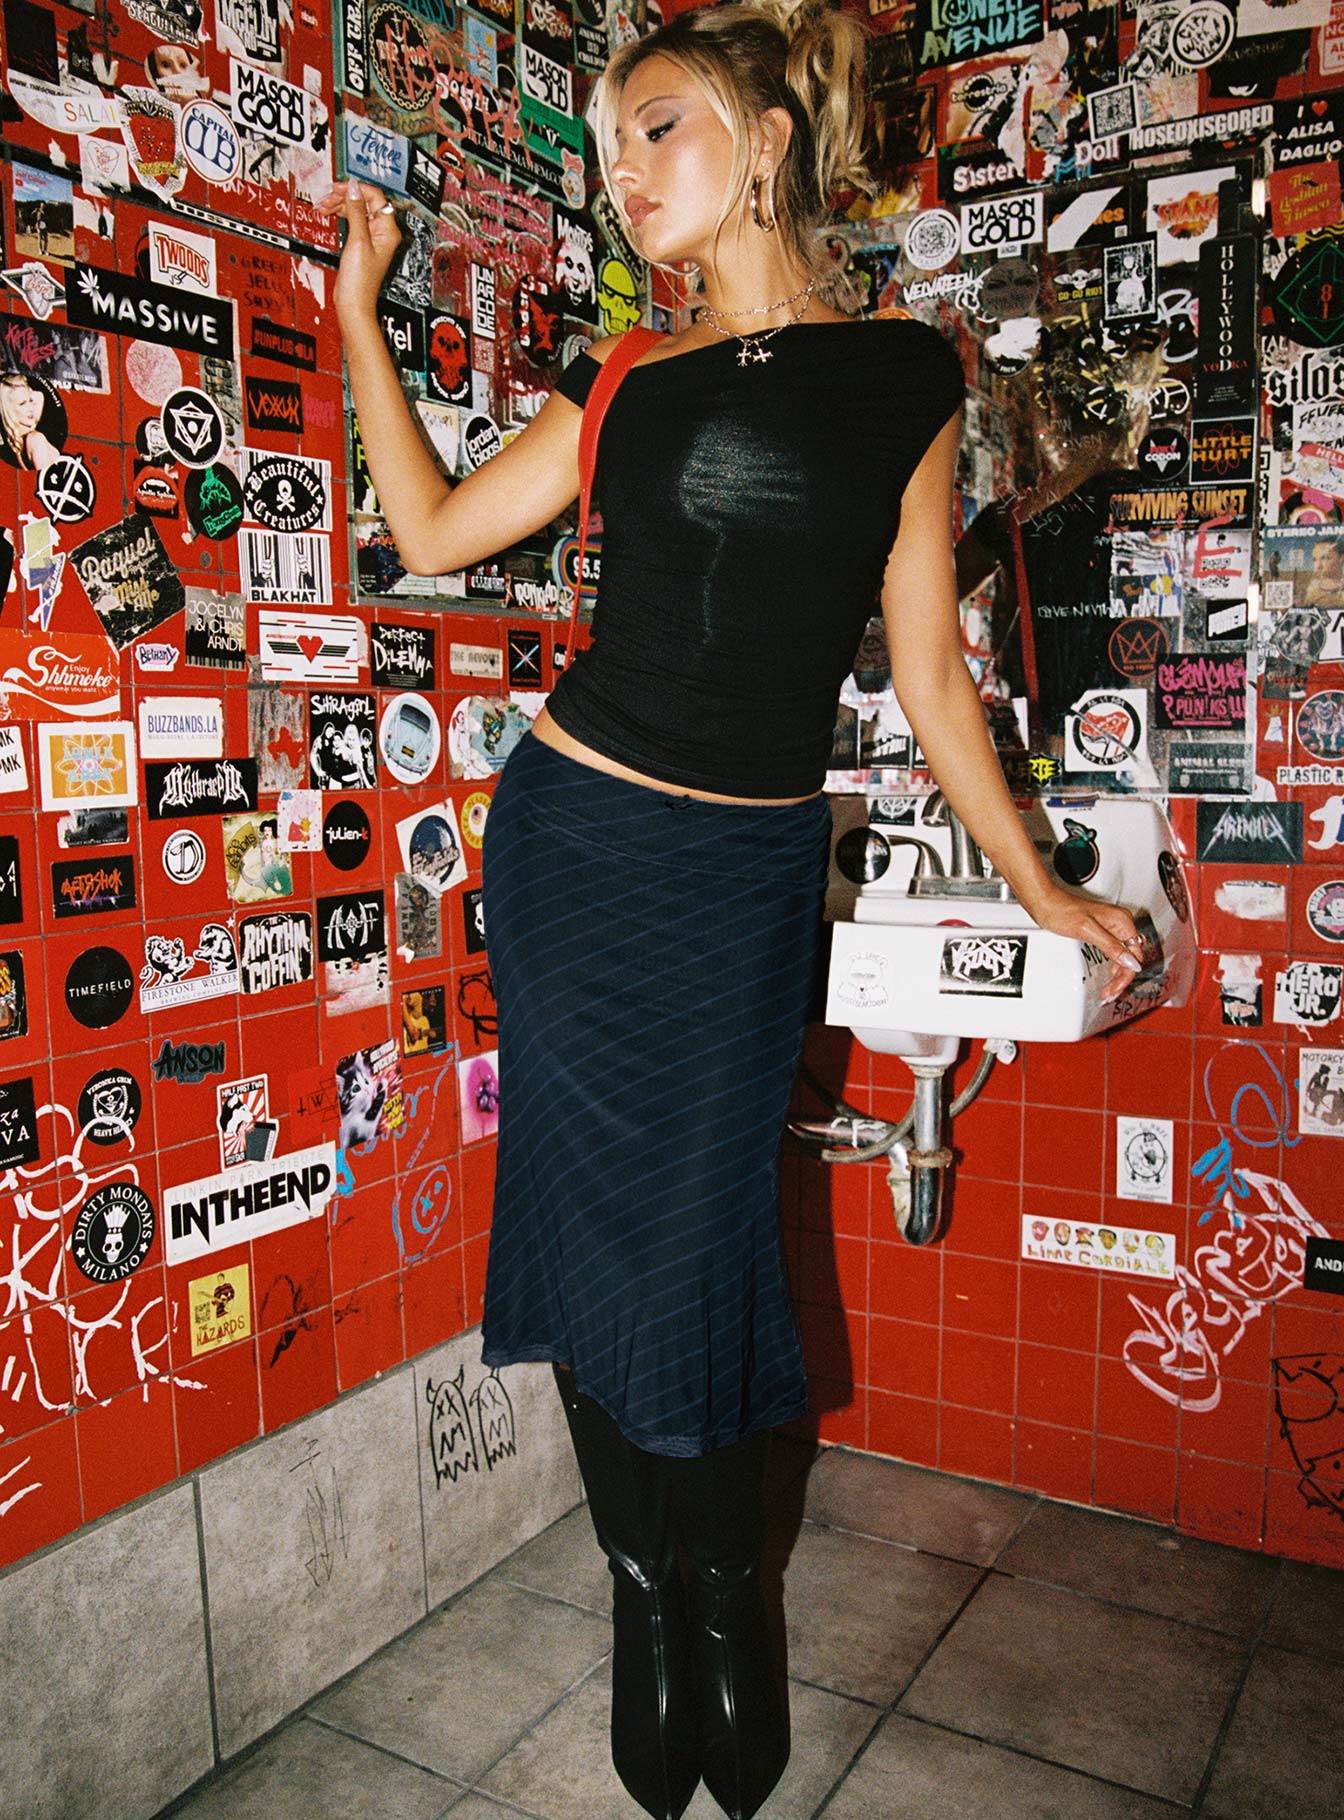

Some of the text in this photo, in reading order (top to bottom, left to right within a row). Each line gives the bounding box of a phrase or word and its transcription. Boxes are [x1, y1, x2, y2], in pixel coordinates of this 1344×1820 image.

[920, 4, 1040, 64] AVENUE
[237, 64, 304, 116] MASON
[192, 107, 235, 143] CAPITAL
[238, 91, 305, 142] GOLD
[1286, 121, 1334, 140] ALISA
[1279, 139, 1342, 161] DAGLIO
[968, 198, 1035, 226] MASON
[968, 215, 1036, 248] GOLD
[92, 292, 218, 344] MASSIVE
[1193, 435, 1252, 449] LITTLE
[1193, 448, 1252, 462] HURT
[247, 461, 321, 497] Beautiful
[253, 499, 320, 532] Creatures
[1192, 488, 1247, 518] SUNSET
[1267, 526, 1316, 539] STEREO
[81, 526, 156, 579] Raquel
[189, 600, 244, 621] JOCELYN
[251, 590, 316, 602] BLAKHAT
[195, 617, 244, 638] & CHRIS
[207, 636, 242, 652] ARNDT
[20, 646, 113, 688] Shhmoke
[69, 664, 90, 674] Enjoy
[148, 715, 218, 733] BUZZBANDS.LA
[1279, 767, 1331, 784] PLASTIC
[244, 919, 309, 963] RHYTHM
[246, 951, 303, 994] COFFIN
[1279, 972, 1338, 999] HERO
[68, 978, 132, 998] TIMEFIELD
[142, 973, 239, 1002] FIRESTONE WALKER
[173, 1180, 223, 1203] LINKIN
[230, 1167, 267, 1188] PARK
[74, 1186, 153, 1241] DIRTY MONDAYS
[81, 1254, 141, 1282] MILANO
[195, 1315, 246, 1347] HAZARDS
